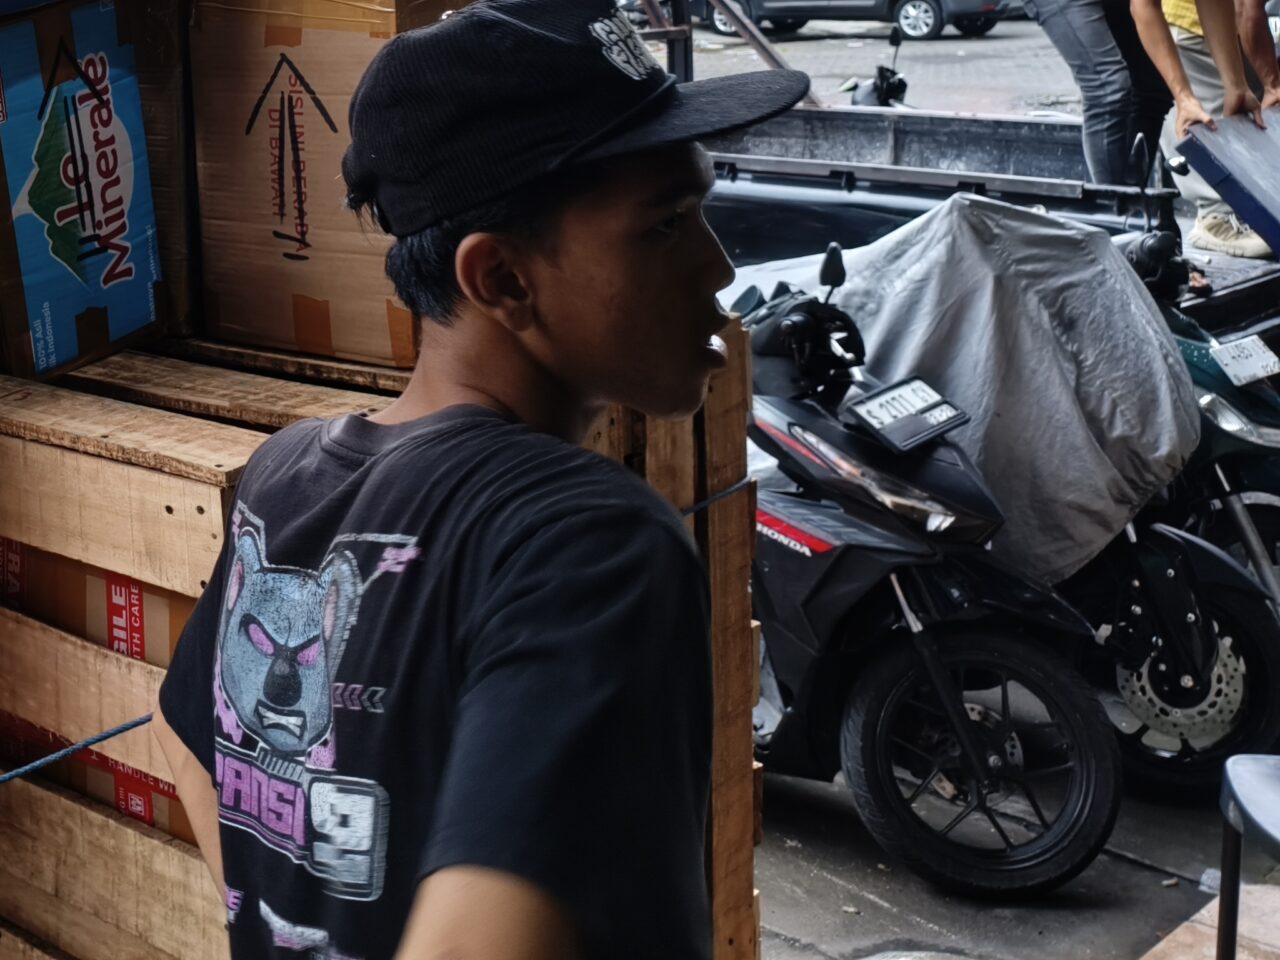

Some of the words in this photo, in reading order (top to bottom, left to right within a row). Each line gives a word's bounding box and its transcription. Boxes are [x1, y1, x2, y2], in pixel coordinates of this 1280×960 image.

[56, 155, 90, 226] Le
[80, 54, 134, 287] Minerale
[41, 301, 56, 353] Indonesia
[756, 522, 812, 557] HONDA
[130, 583, 141, 627] CARE
[131, 631, 141, 659] ITH
[215, 751, 305, 846] ANSI
